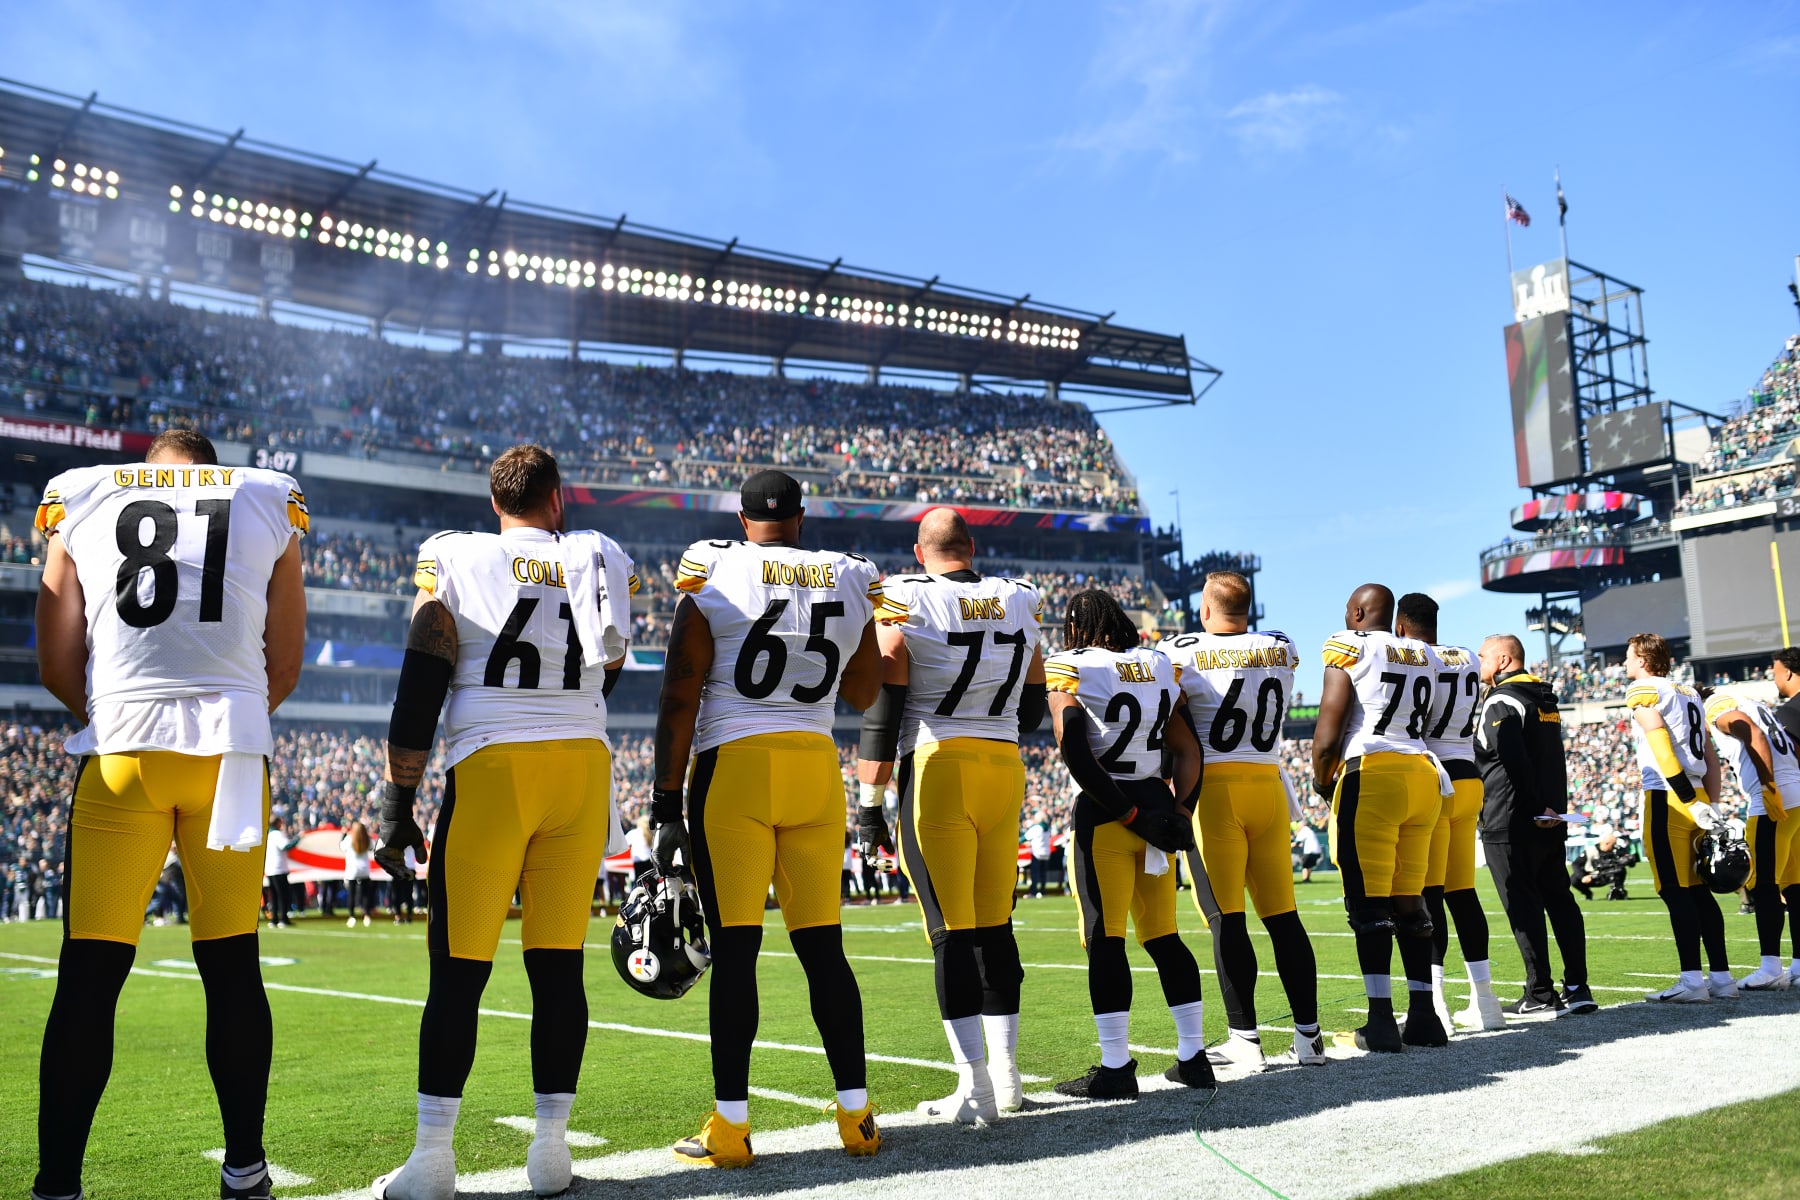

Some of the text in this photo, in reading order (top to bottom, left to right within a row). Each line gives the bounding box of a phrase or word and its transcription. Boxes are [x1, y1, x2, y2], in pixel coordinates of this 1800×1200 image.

[75, 426, 122, 452] Field
[114, 468, 235, 488] GENTRY
[255, 449, 298, 472] 3:07
[116, 499, 231, 629] 81
[513, 557, 567, 589] COLE
[762, 560, 836, 588] MOORE
[958, 597, 1005, 621] DAVIS
[484, 598, 583, 691] 61
[734, 599, 845, 704] 65
[1195, 647, 1288, 671] HASSENAUER
[1385, 644, 1429, 667] DANIELS
[934, 628, 1027, 717] 77
[1116, 661, 1156, 683] SNELL
[1208, 677, 1284, 753] 60
[1373, 672, 1432, 740] 78
[1429, 671, 1480, 739] 72
[1097, 688, 1172, 774] 24
[1757, 705, 1796, 756] 8
